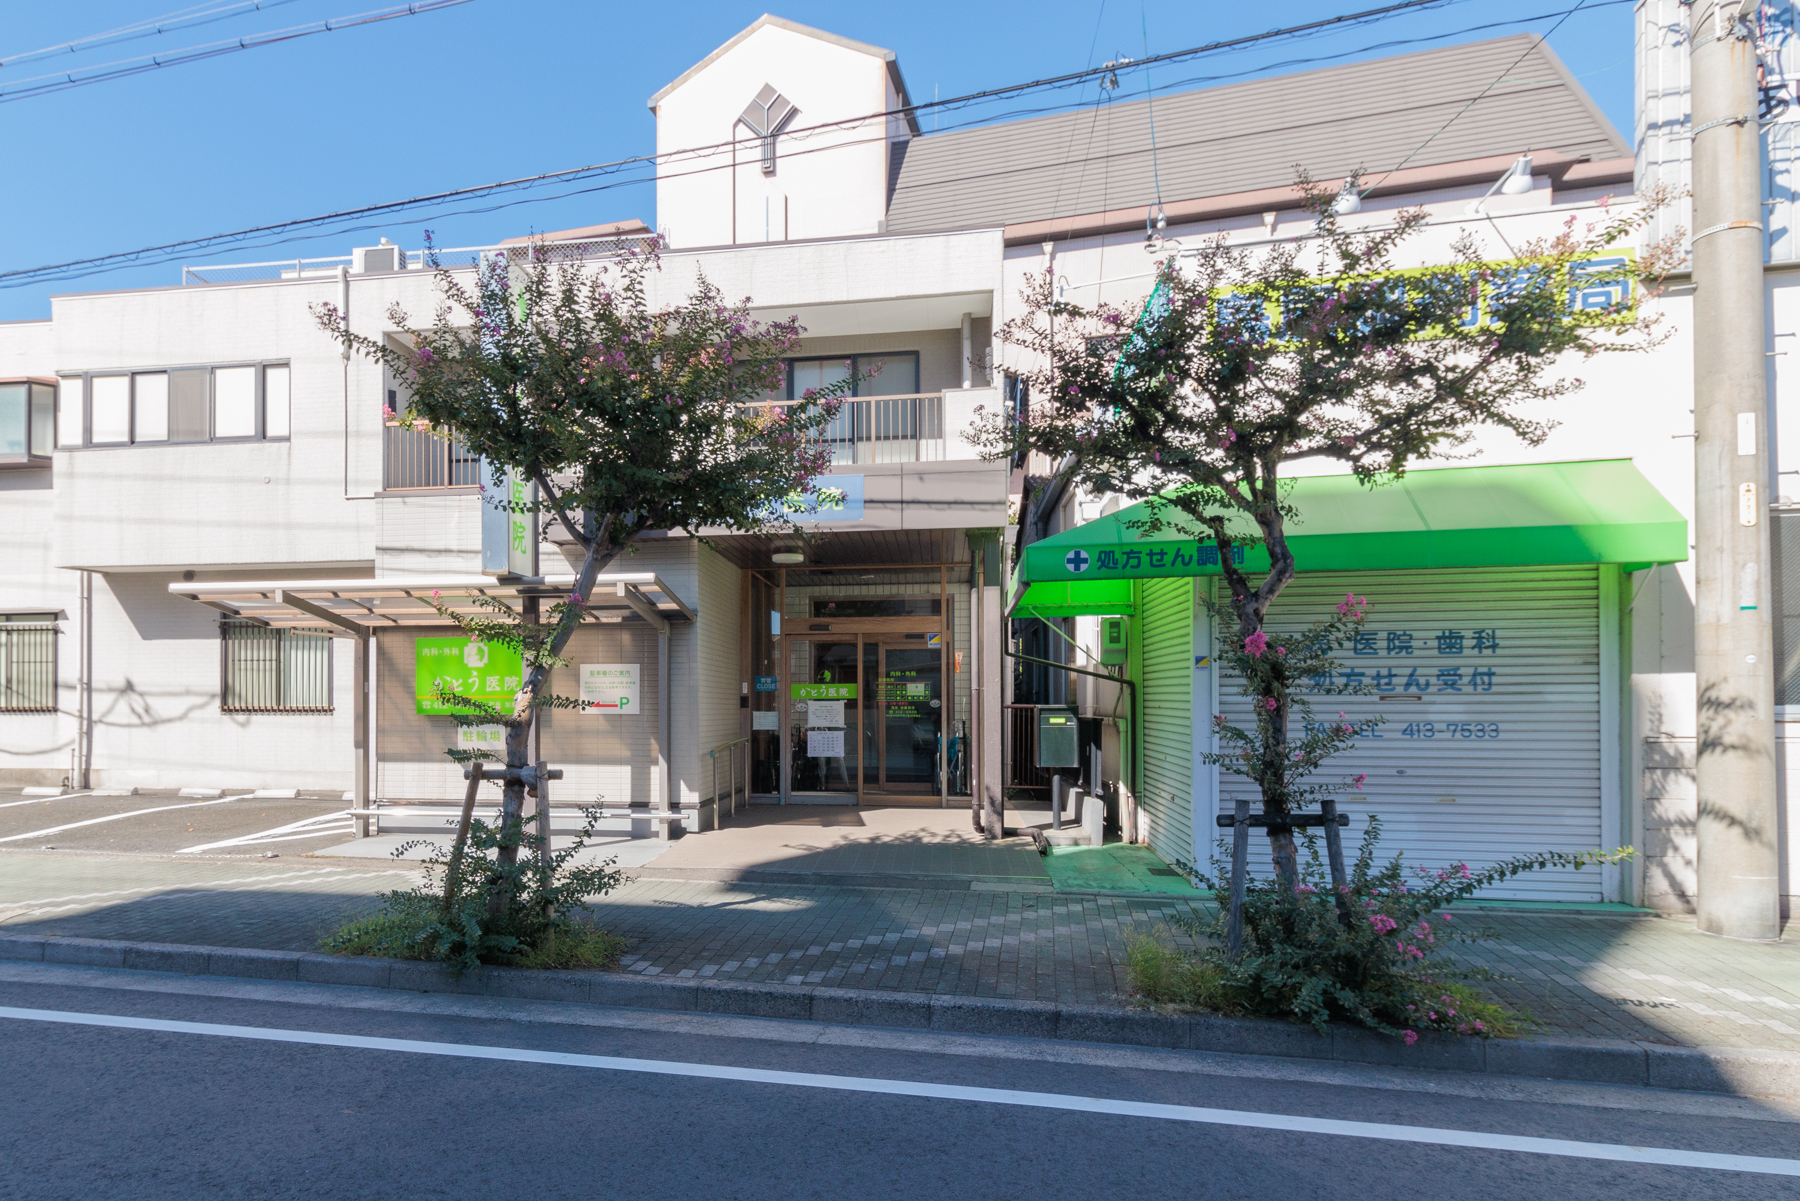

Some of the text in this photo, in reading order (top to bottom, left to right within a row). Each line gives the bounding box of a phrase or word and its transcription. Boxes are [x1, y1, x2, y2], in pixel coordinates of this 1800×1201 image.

[422, 647, 460, 656] 内科・外科
[433, 670, 520, 694] かとう医院
[1308, 667, 1497, 692] 処方せん受付
[800, 685, 849, 697] かとう医院
[620, 697, 630, 709] P
[462, 730, 501, 742] 駐輪場
[1401, 722, 1500, 738] 413-7533
